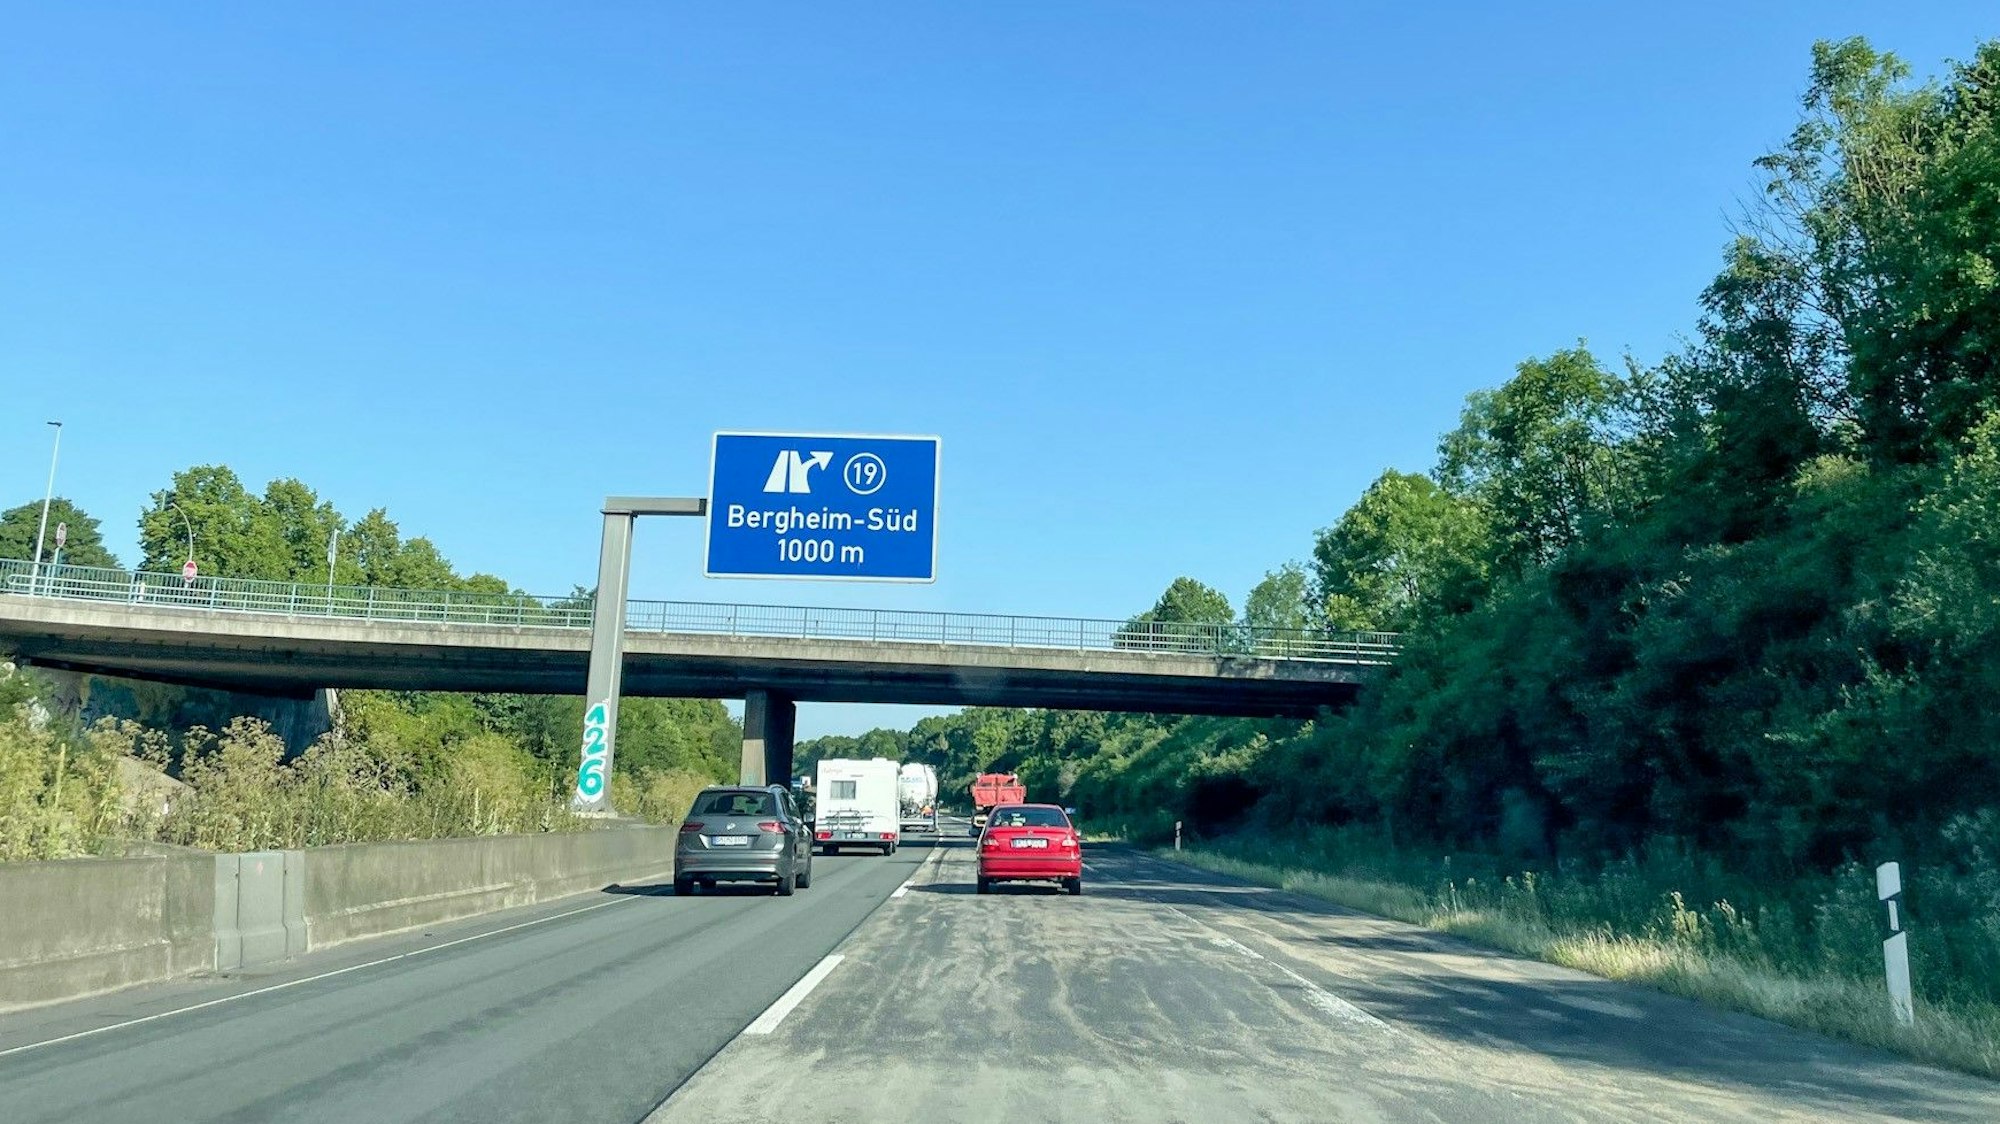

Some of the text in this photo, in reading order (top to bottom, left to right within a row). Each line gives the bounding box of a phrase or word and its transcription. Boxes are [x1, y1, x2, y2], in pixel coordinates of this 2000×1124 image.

[853, 462, 878, 485] 19
[727, 504, 918, 535] Bergheim-Süd
[778, 538, 864, 564] 1000 m
